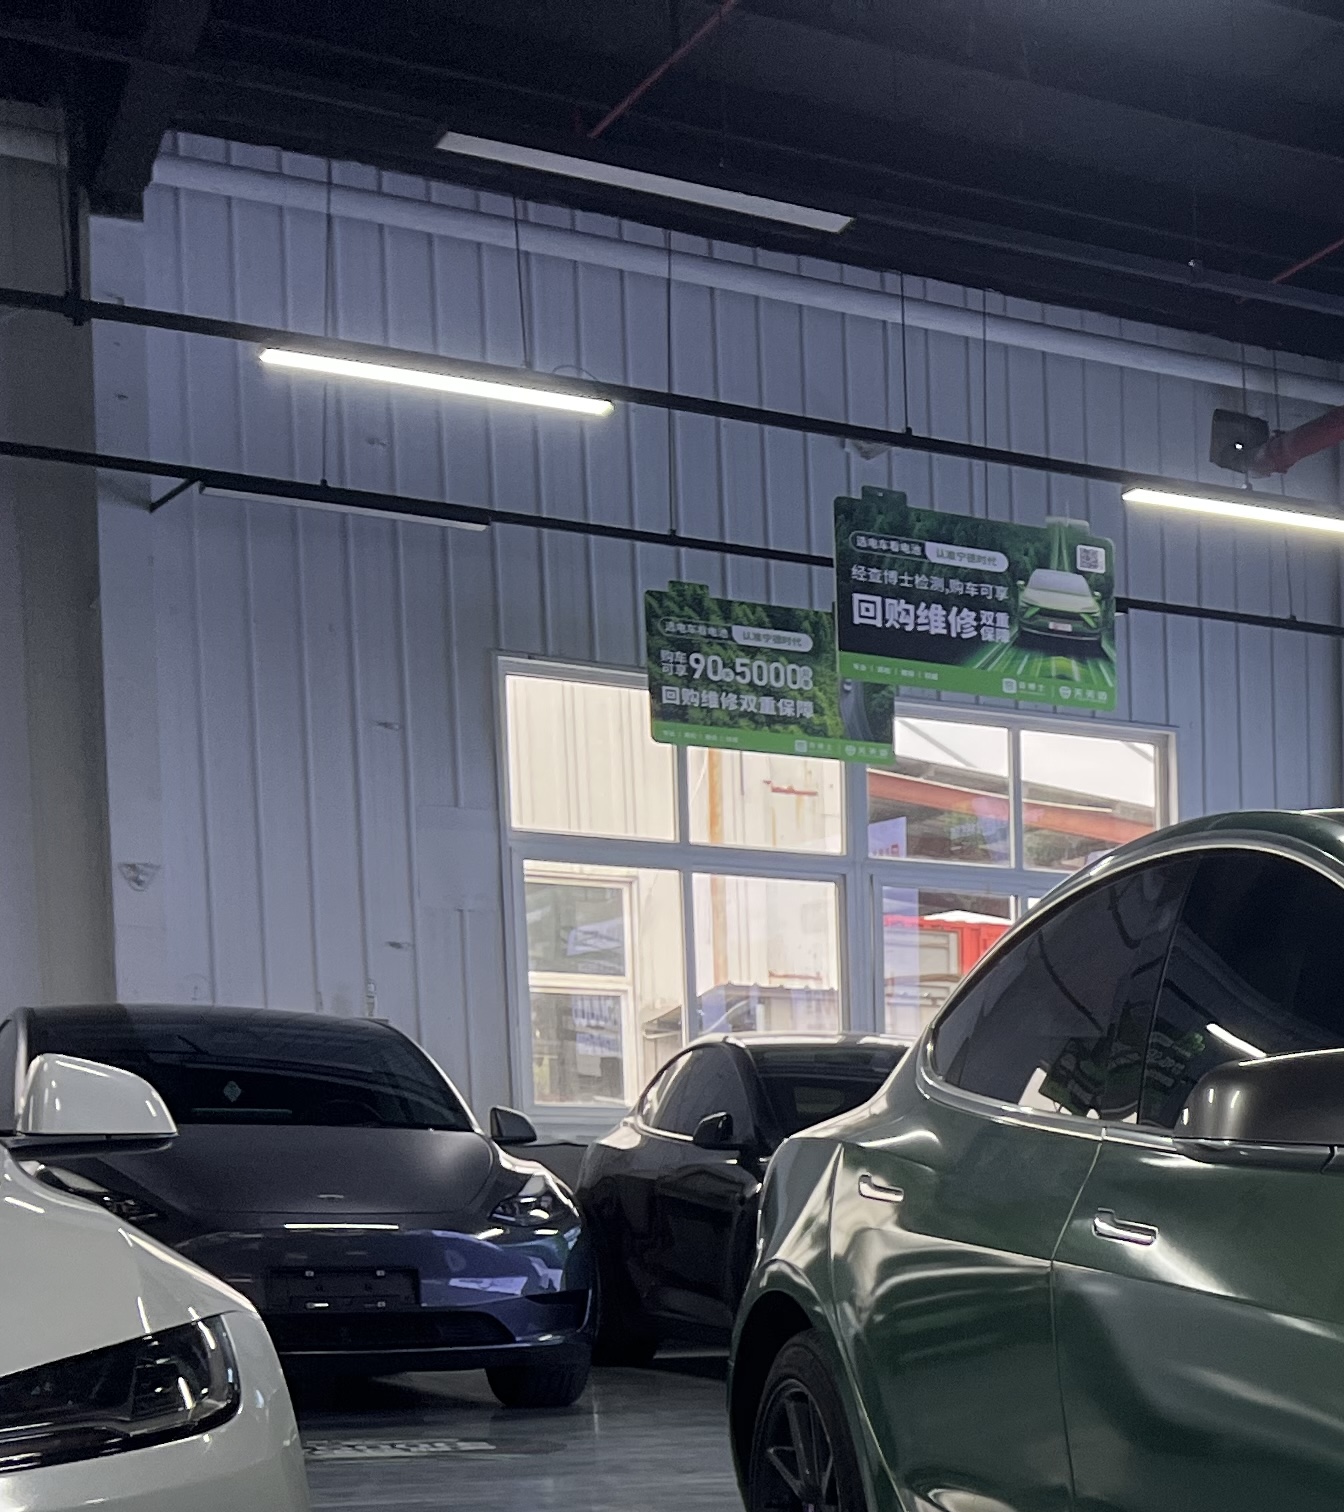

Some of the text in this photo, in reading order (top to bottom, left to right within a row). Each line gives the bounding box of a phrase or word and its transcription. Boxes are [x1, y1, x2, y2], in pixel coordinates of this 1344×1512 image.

[851, 564, 1008, 601] 经查博士检测,购车可享
[662, 686, 813, 718] 回购维修双重保障
